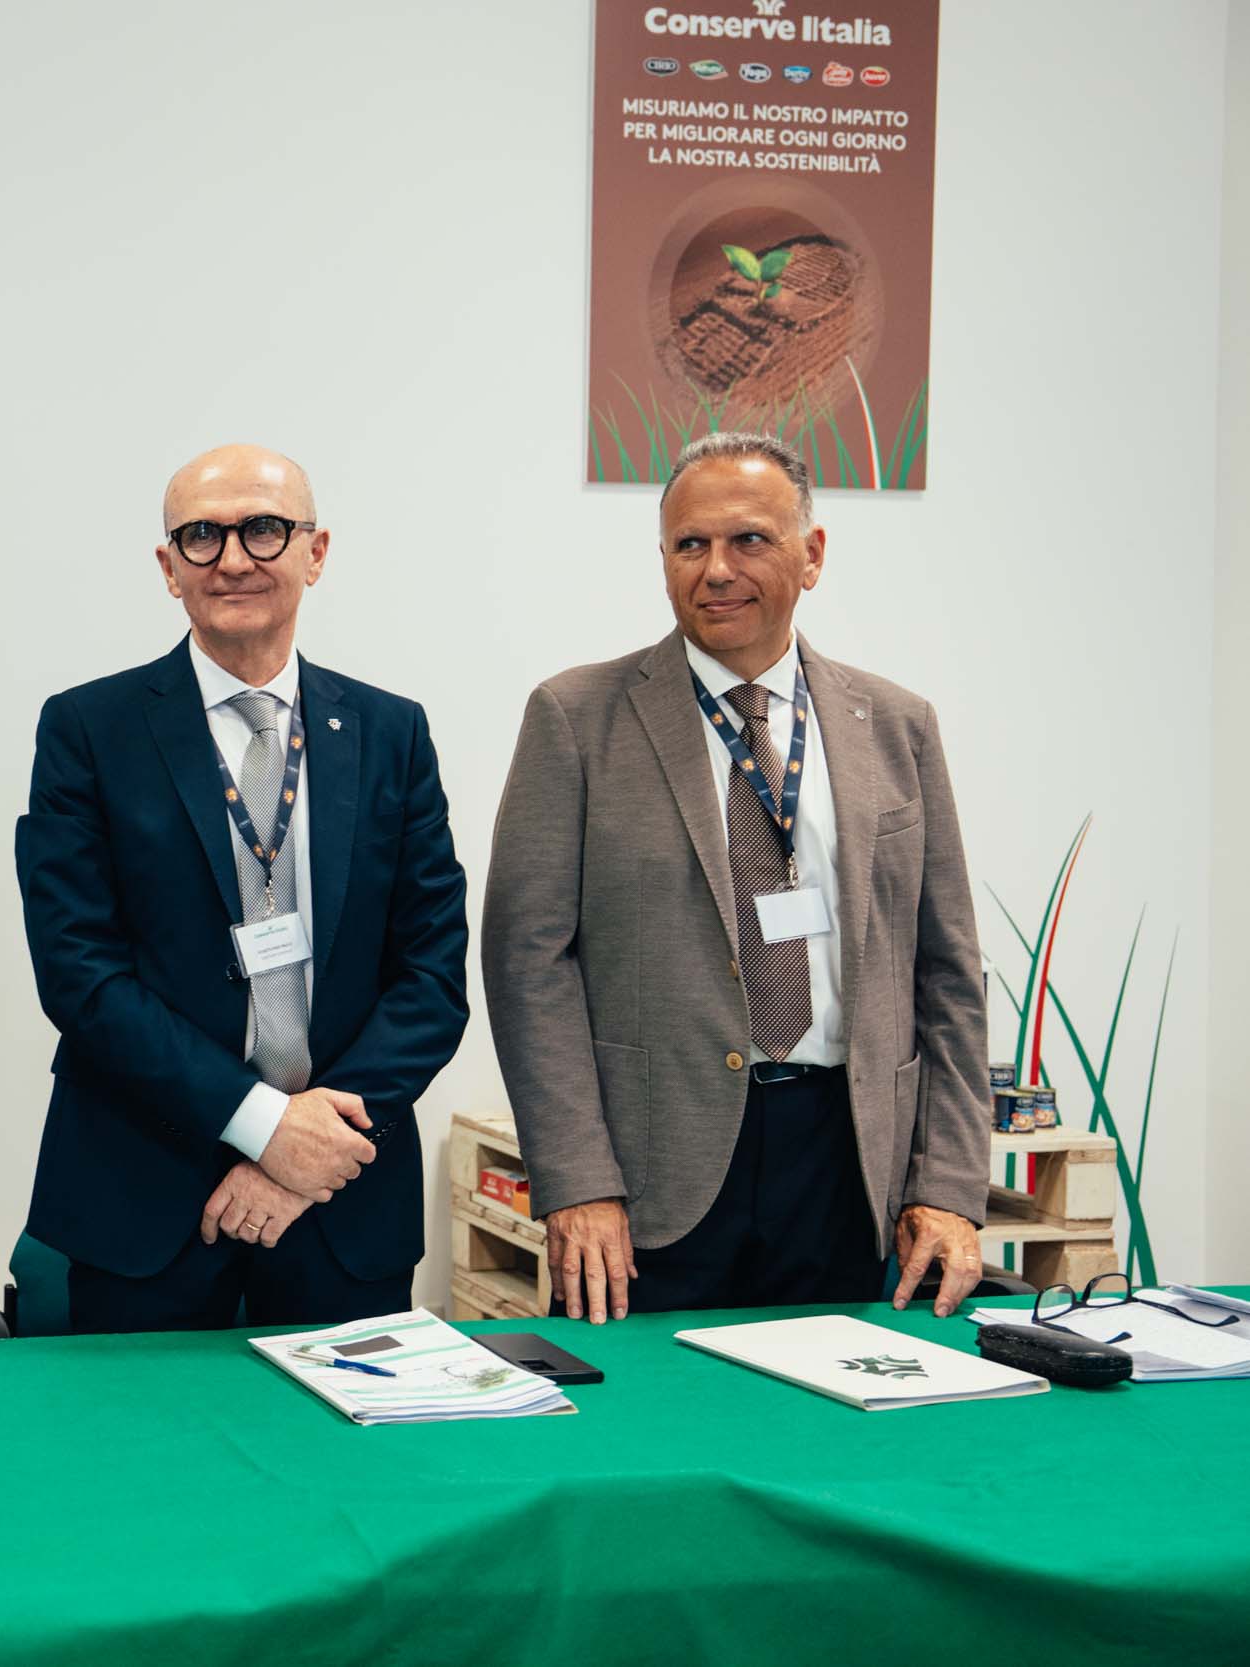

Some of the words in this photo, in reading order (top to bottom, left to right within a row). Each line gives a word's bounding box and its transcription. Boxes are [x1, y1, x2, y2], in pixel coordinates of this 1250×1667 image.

[644, 7, 796, 40] Conserve
[622, 98, 729, 119] MISURIAMO
[733, 104, 749, 120] IL
[753, 105, 827, 125] NOSTRO
[832, 108, 909, 128] IMPATTO
[623, 122, 657, 139] PER
[662, 125, 775, 145] MIGLIORARE
[779, 130, 828, 148] OGNI
[832, 132, 907, 151] GIORNO
[648, 147, 672, 164] LA
[677, 149, 750, 168] NOSTRA
[754, 152, 881, 174] SOSTENIBILITÀ
